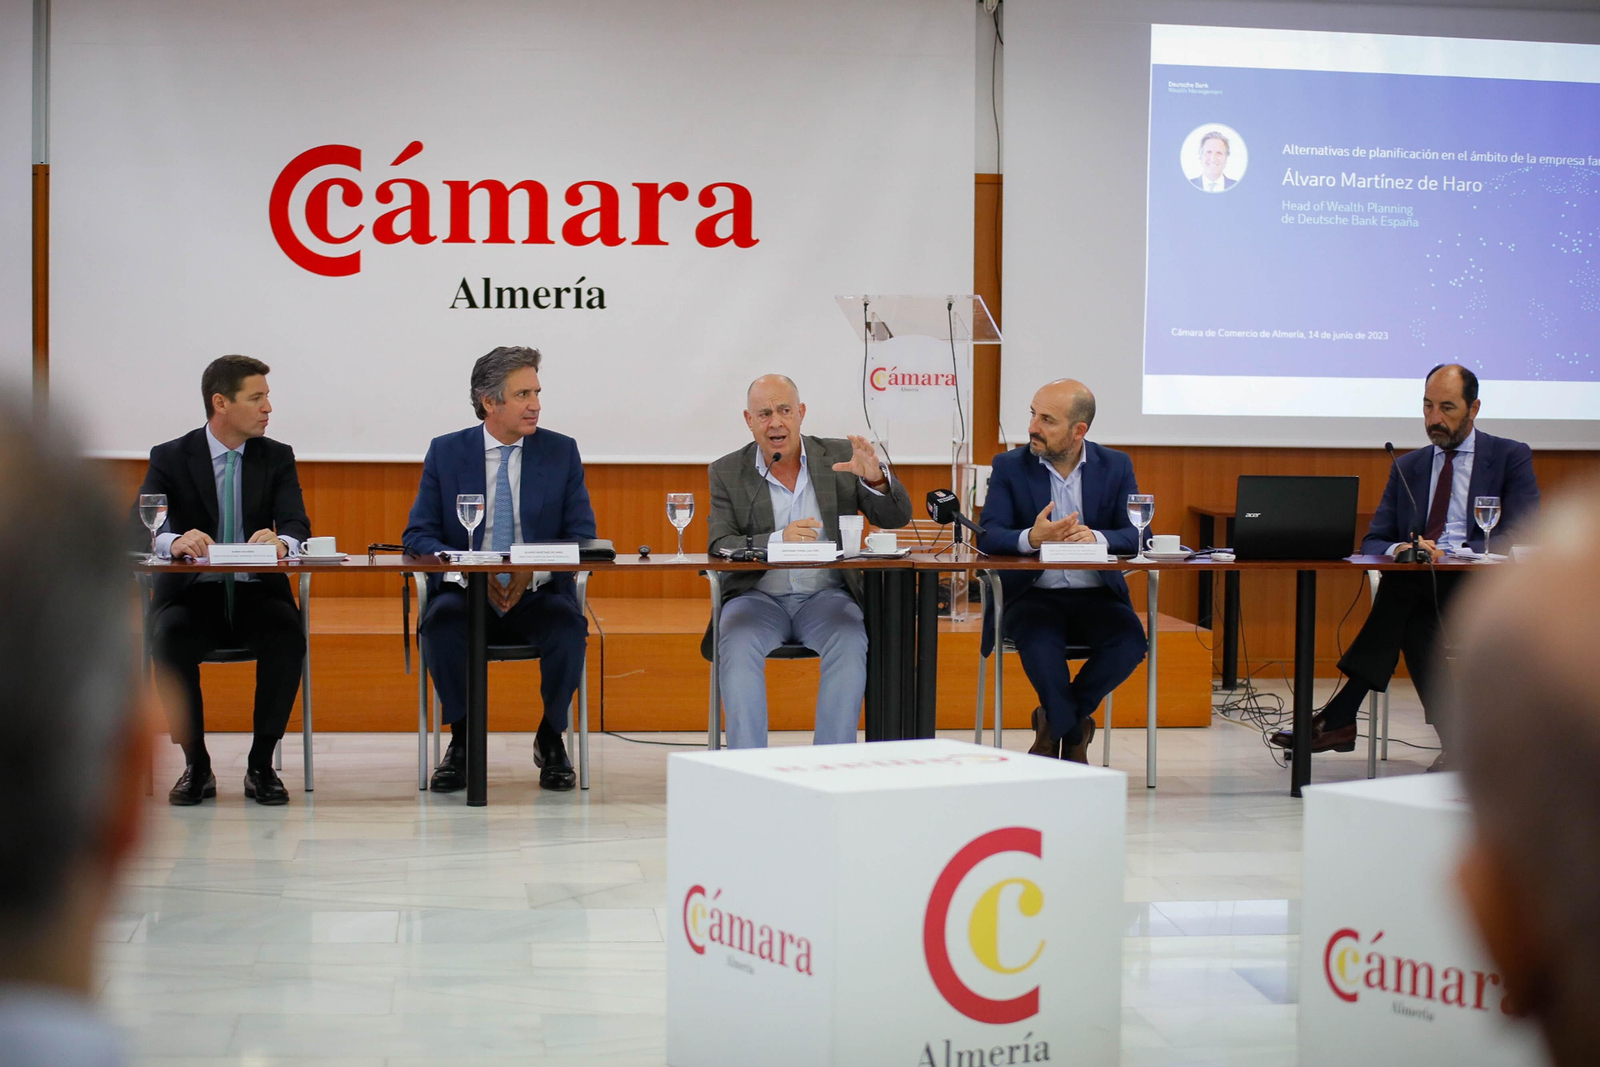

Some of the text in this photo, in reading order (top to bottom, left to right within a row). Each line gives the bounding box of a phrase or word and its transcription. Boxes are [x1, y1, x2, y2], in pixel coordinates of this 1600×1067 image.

[1282, 144, 1350, 157] Alternativas
[1352, 147, 1366, 157] de
[1369, 147, 1439, 160] planificación
[1441, 151, 1455, 161] en
[1457, 151, 1467, 161] el
[1470, 151, 1508, 163] ámbito
[1510, 152, 1524, 163] de
[1527, 153, 1536, 164] la
[1539, 156, 1585, 167] empresa
[1282, 167, 1482, 192] Álvaro Martínez de Haro
[1281, 200, 1414, 216] Head of Wealth Planning
[1281, 213, 1419, 229] de Deutsche Bank España
[449, 276, 607, 310] Almería
[1171, 327, 1204, 337] Cámara
[1205, 329, 1216, 337] de
[1218, 328, 1258, 338] Comercio
[1259, 330, 1270, 338] de
[1308, 330, 1319, 339] 14
[1320, 330, 1331, 339] de
[1332, 330, 1353, 341] junio
[1354, 331, 1366, 340] de
[1367, 331, 1389, 340] 2023
[917, 1030, 1051, 1067] Almería
